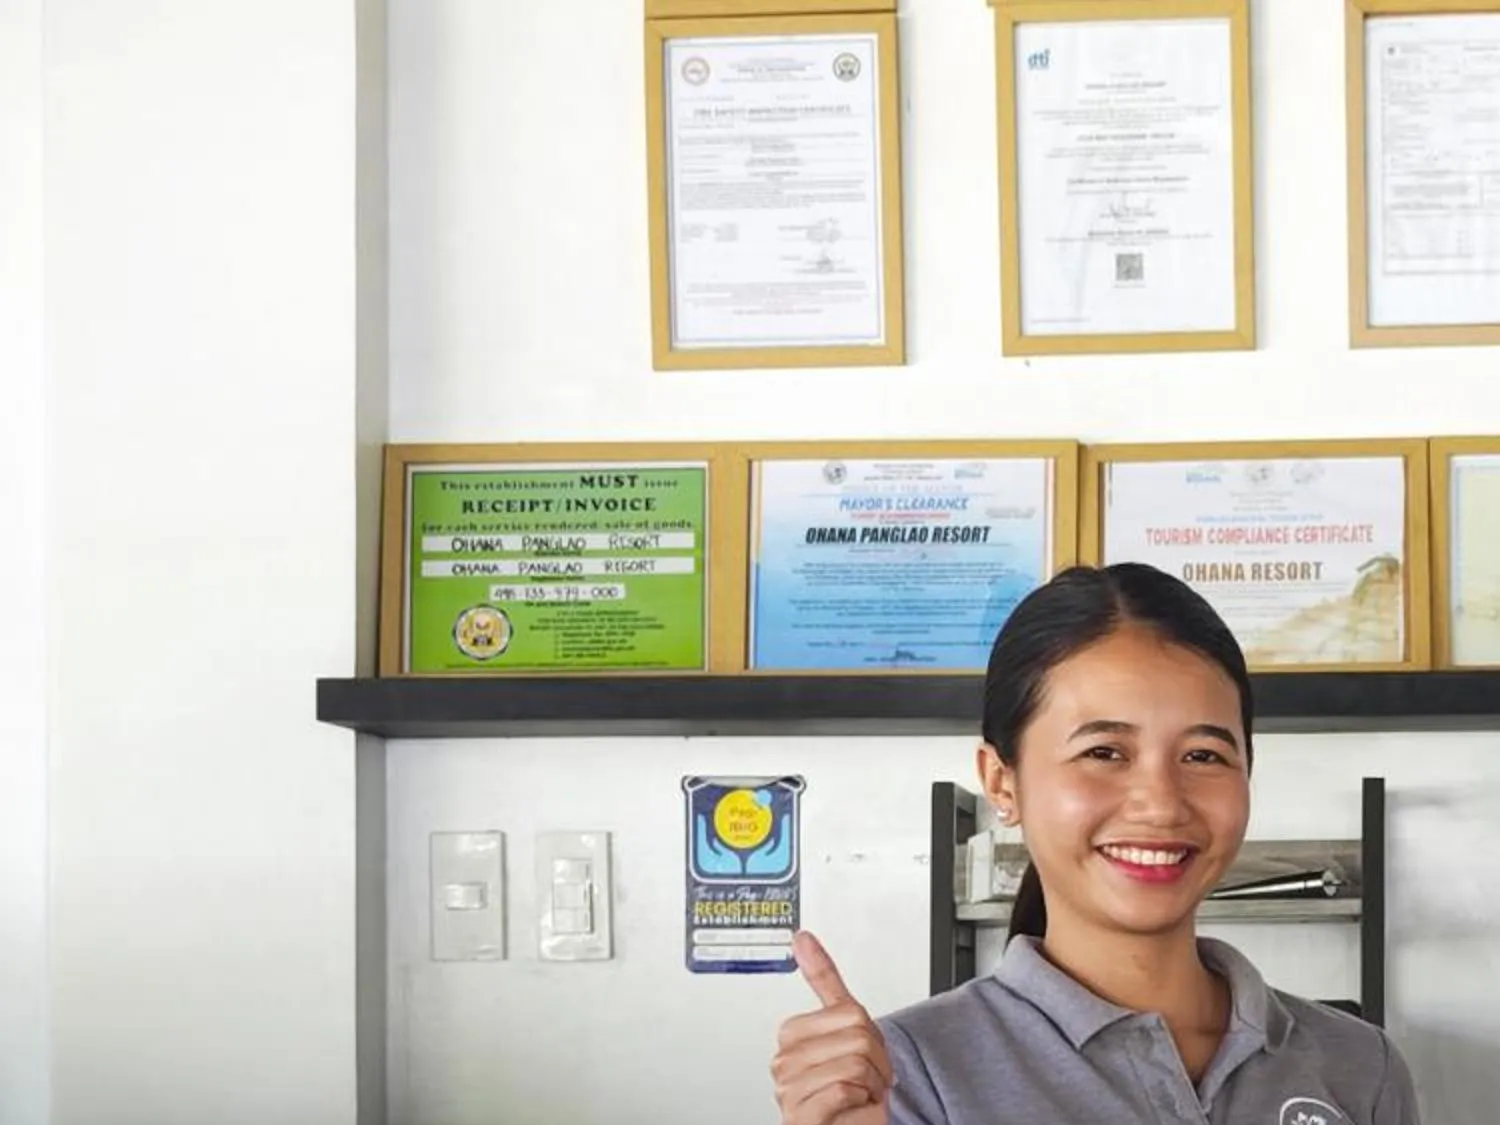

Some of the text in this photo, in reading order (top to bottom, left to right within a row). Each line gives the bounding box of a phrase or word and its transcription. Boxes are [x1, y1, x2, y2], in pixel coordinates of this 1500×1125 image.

[440, 480, 471, 491] This
[474, 479, 575, 490] establishment
[579, 474, 640, 489] MUST
[461, 497, 658, 514] RECEIPT/INVOICE
[895, 498, 969, 511] CLEARANCE
[451, 533, 661, 552] OHANA PANGLAO RESORT
[805, 525, 991, 544] OHANA PANGLAO RESORT
[1146, 524, 1374, 546] TOURISM COMPLIANCE CERTIFICATE
[1183, 562, 1323, 582] OHANA RESORT
[694, 902, 792, 916] REGISTERED
